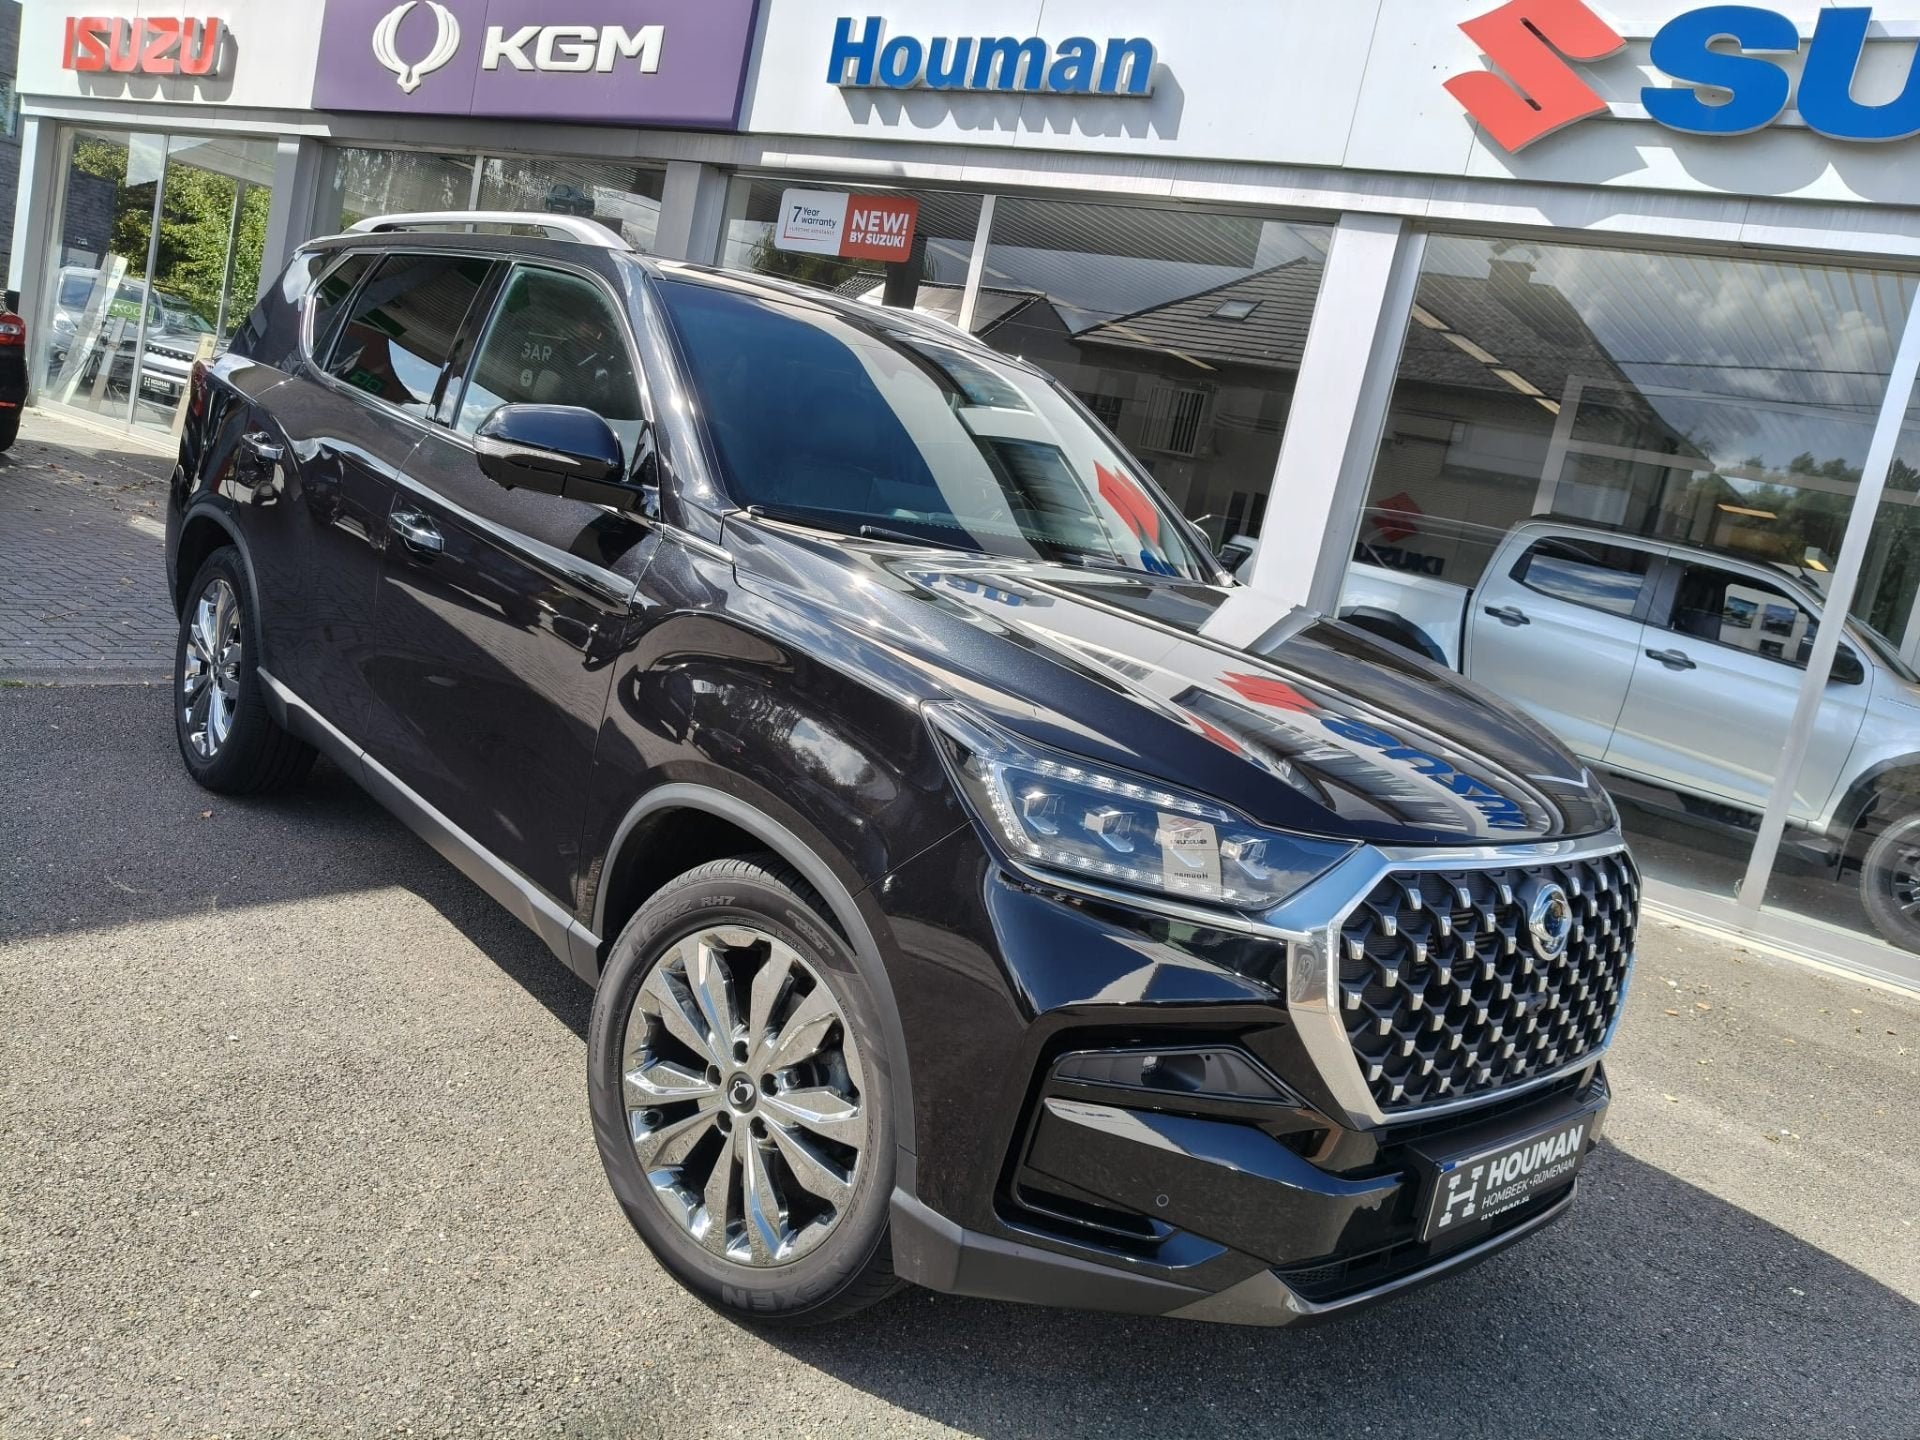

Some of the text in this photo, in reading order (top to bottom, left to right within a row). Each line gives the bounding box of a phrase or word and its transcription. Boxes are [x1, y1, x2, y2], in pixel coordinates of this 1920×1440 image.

[62, 16, 223, 76] ISUZU
[482, 25, 664, 74] KGM
[826, 15, 1157, 95] Houman
[1640, 5, 1920, 142] SU
[793, 205, 821, 223] 7 Year
[801, 217, 837, 229] warranty
[851, 209, 910, 235] NEW!
[849, 231, 906, 248] BY SUZUKI
[701, 895, 736, 907] RH7
[1486, 1124, 1585, 1190] HOUMAN
[1482, 1177, 1530, 1210] HOMBEEK
